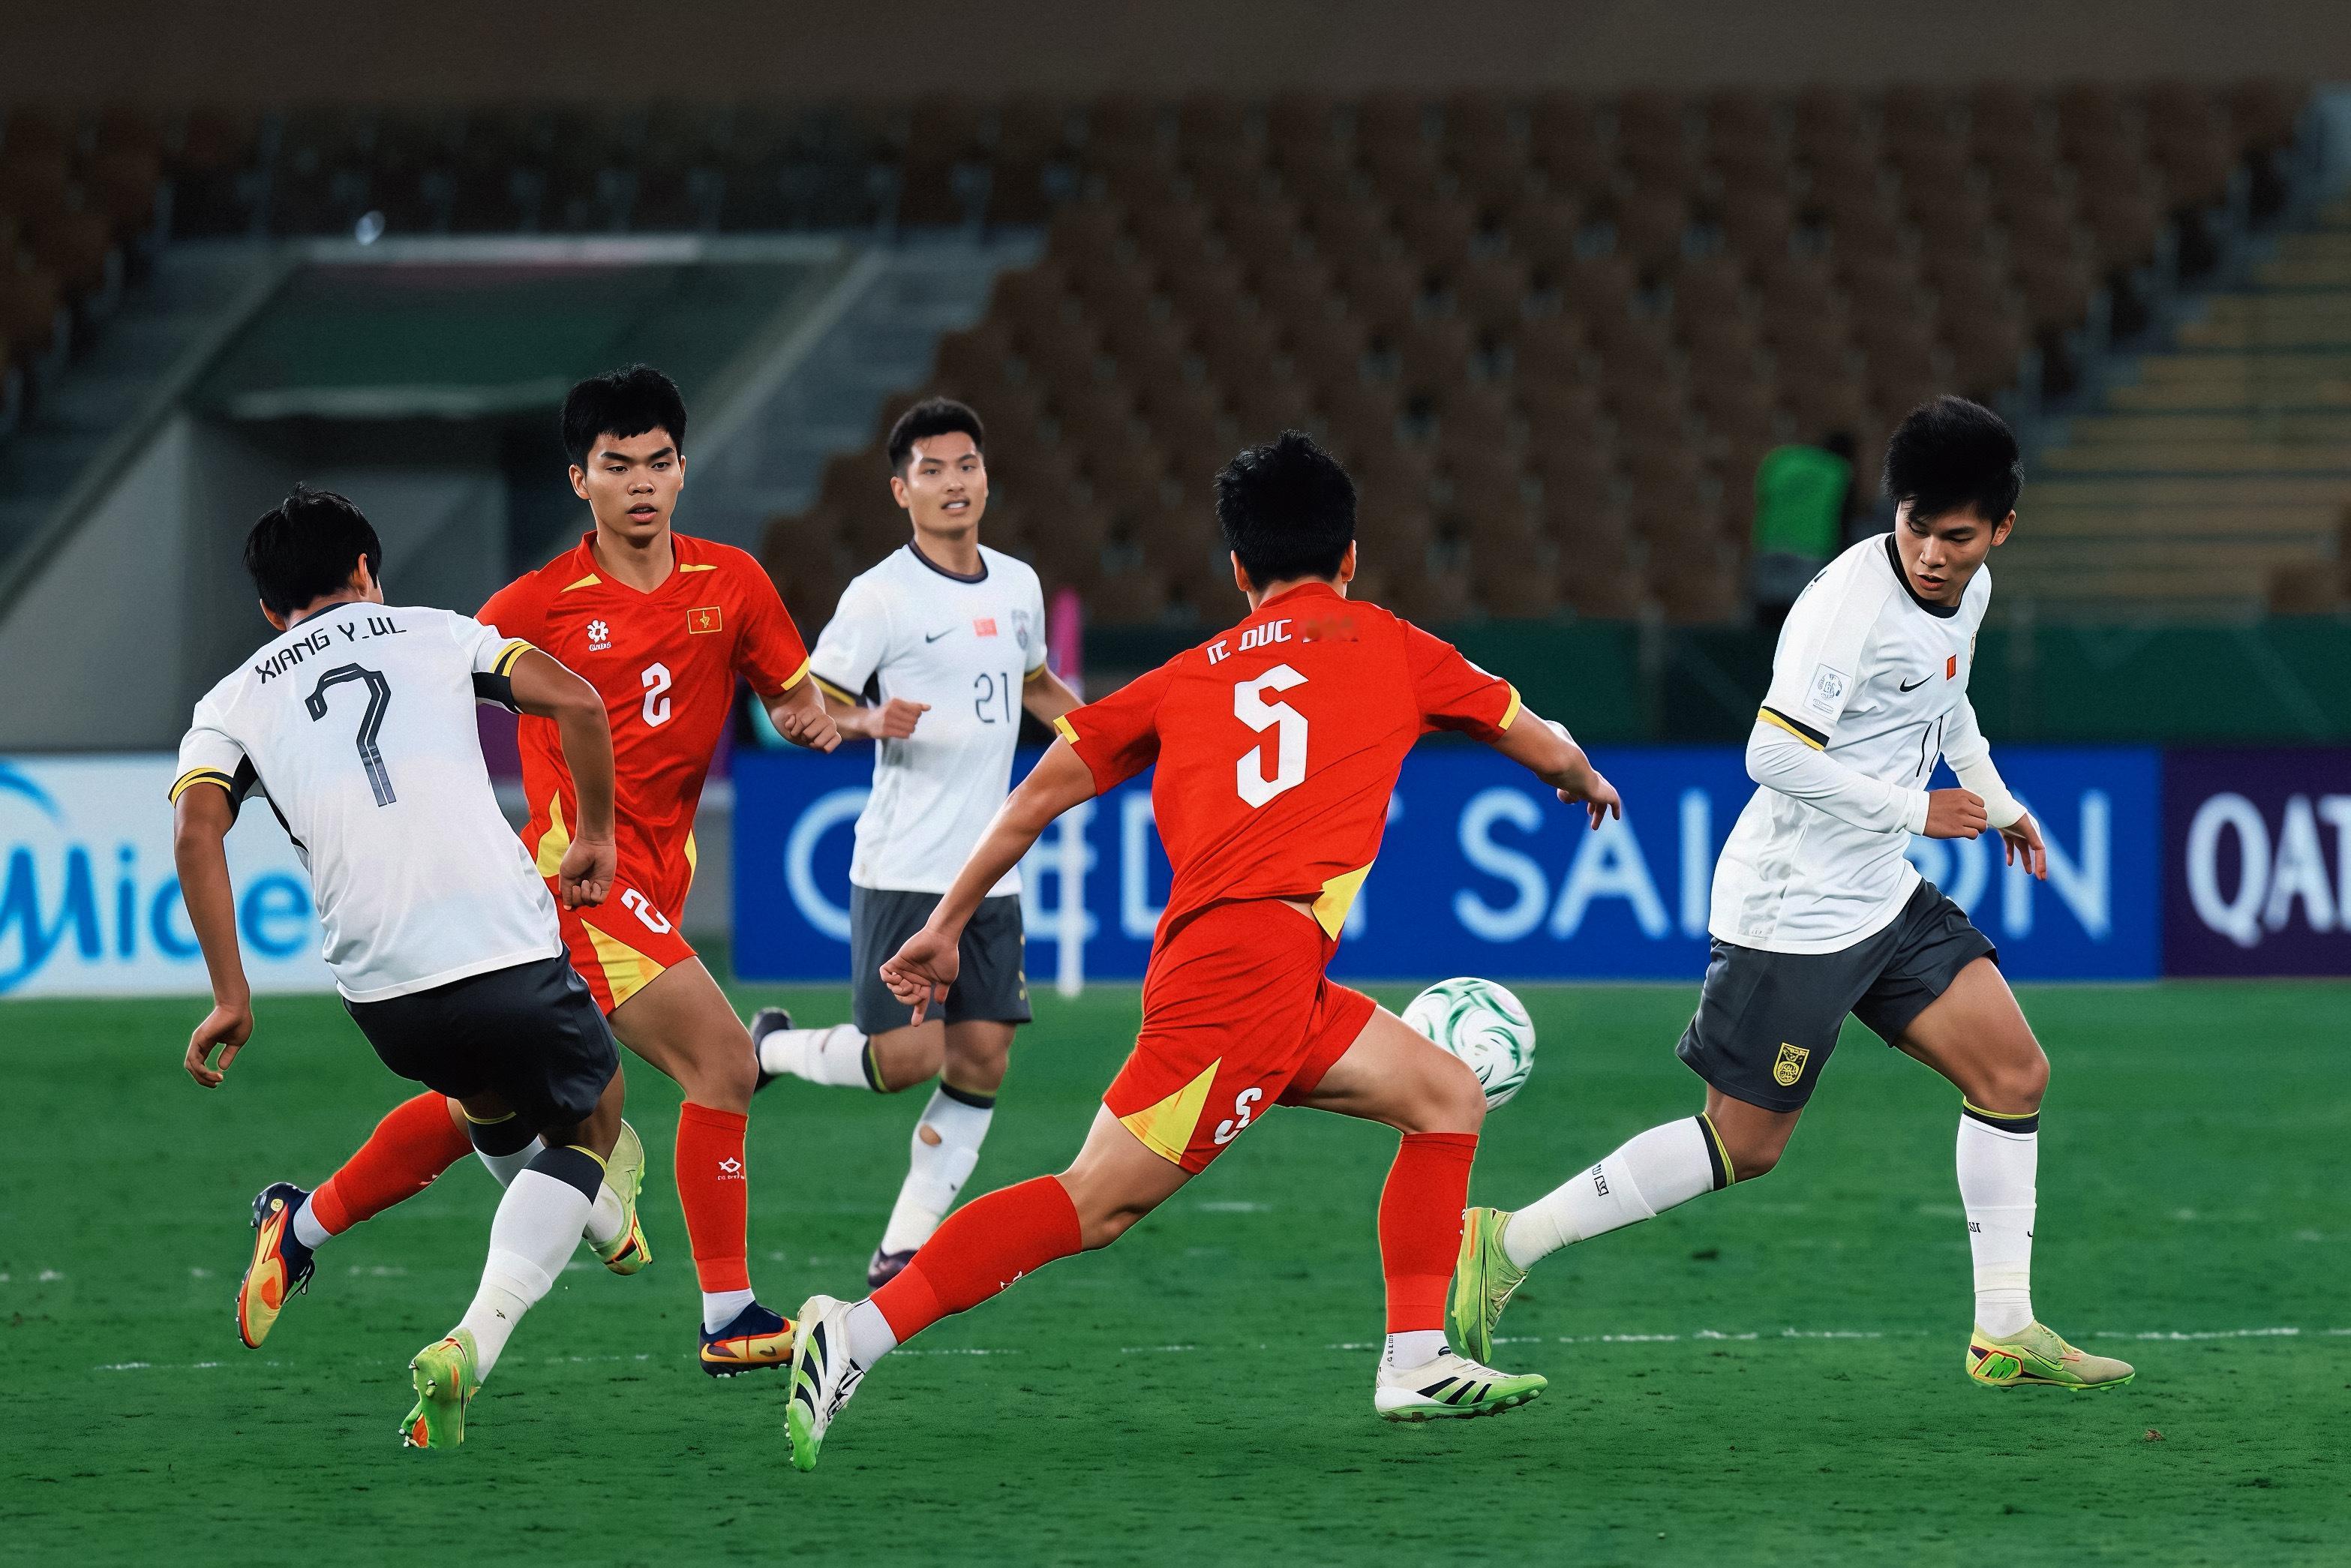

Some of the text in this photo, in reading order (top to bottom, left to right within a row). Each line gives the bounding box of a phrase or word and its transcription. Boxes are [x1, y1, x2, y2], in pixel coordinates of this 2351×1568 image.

[254, 627, 331, 684] XIANG
[1238, 618, 1293, 652] DUC
[641, 662, 672, 728] 2
[974, 672, 1010, 723] 21
[304, 662, 397, 807] 7
[1233, 662, 1310, 810] 5
[620, 888, 672, 935] 2
